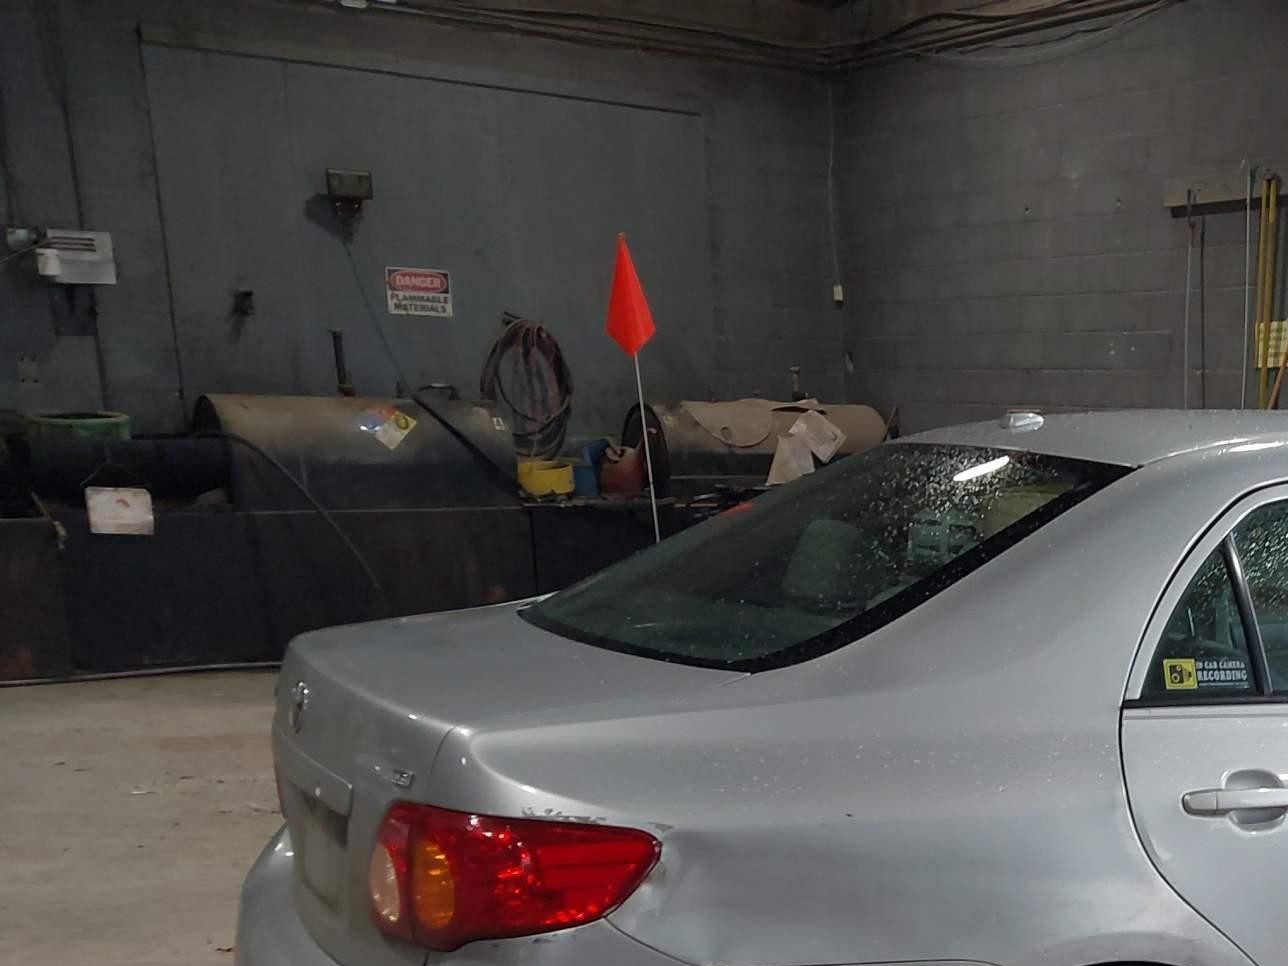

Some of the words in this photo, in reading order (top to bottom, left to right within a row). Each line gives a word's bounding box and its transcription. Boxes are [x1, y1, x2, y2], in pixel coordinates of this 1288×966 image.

[395, 275, 441, 288] DANGER
[391, 292, 448, 304] FLAMMABLE
[394, 302, 447, 313] MATERIALS
[1204, 661, 1218, 669] CAR
[1219, 661, 1245, 669] CAMERA
[1197, 670, 1248, 681] RECORDING
